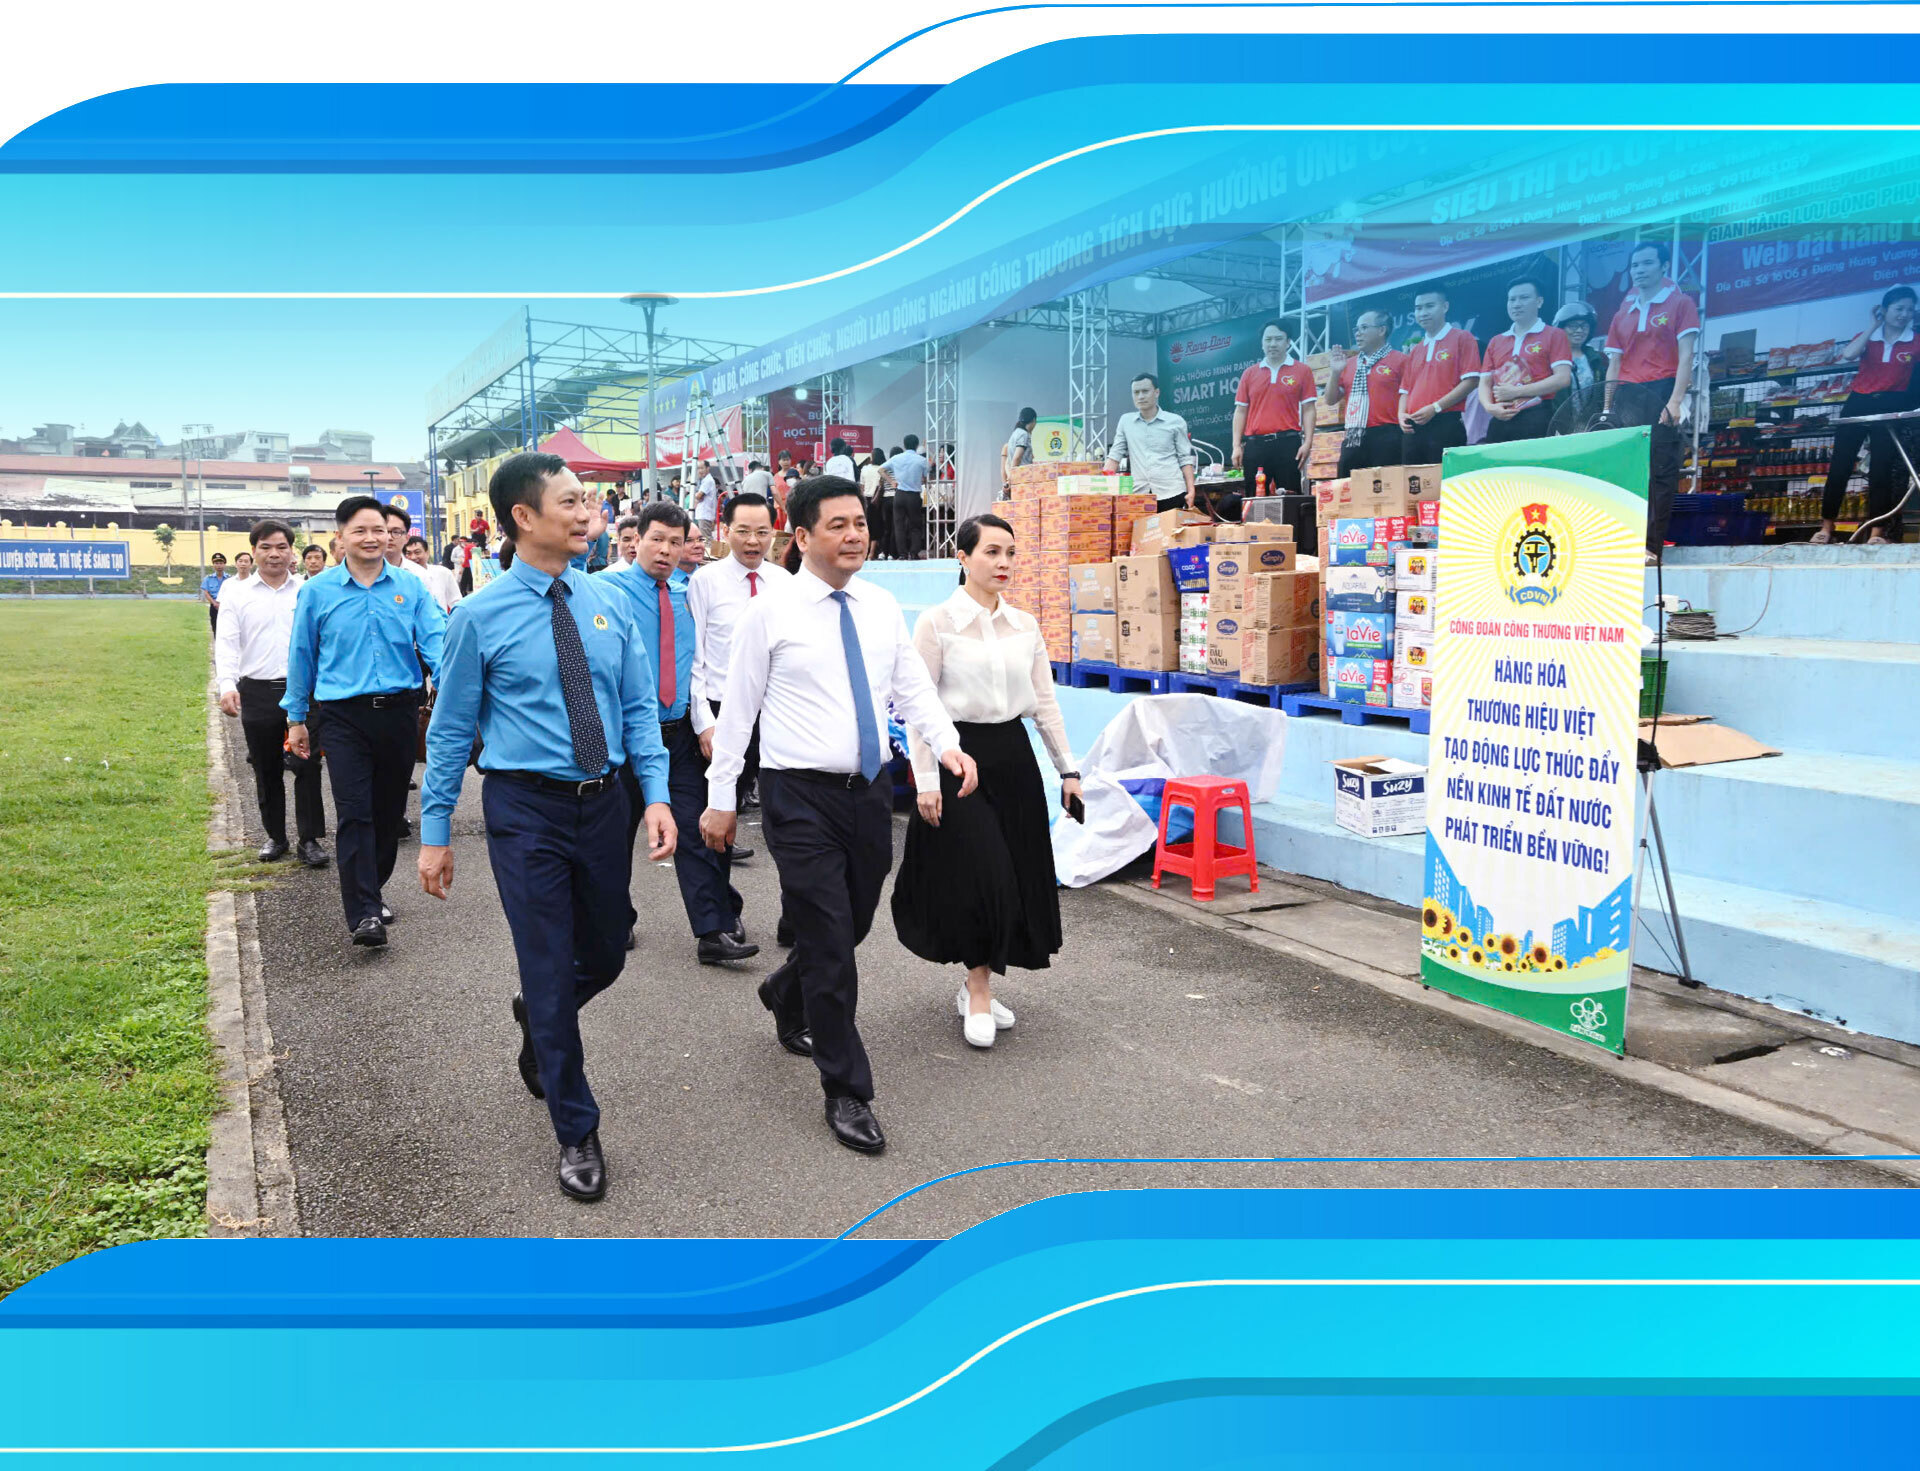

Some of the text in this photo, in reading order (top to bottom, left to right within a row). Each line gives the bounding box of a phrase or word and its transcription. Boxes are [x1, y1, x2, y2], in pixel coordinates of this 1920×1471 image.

[1429, 178, 1498, 224] SIÊU
[1507, 160, 1557, 203] THỊ
[1624, 174, 1664, 195] Phường
[1667, 166, 1686, 182] Gia
[1708, 180, 1920, 243] GIAN HÀNG LƯU ĐỘNG PHỤ
[1741, 239, 1790, 271] Web
[1797, 228, 1834, 262] đặt
[1840, 218, 1904, 251] hàng
[712, 377, 726, 397] CÁN
[739, 361, 759, 387] CÔNG
[760, 352, 784, 379] CHỨC,
[785, 343, 805, 370] VIÊN
[806, 332, 834, 360] CHỨC,
[836, 317, 868, 352] NGƯỜI
[869, 315, 891, 340] LAO
[892, 298, 927, 335] ĐỘNG
[929, 276, 977, 320] NGÀNH
[980, 259, 1022, 301] CÔNG
[1025, 230, 1094, 285] THƯƠNG
[1099, 210, 1144, 258] TÍCH
[1149, 191, 1193, 243] CỰC
[1200, 157, 1288, 222] HƯỞNG
[1715, 281, 1731, 293] Địa
[1812, 261, 1846, 276] Đường
[1873, 268, 1899, 282] Điện
[1213, 363, 1232, 376] MINH
[1173, 378, 1240, 404] SMART HO
[783, 427, 807, 440] HỌC
[3, 549, 24, 571] LUYỆN
[25, 548, 38, 569] SỨC
[59, 549, 70, 569] TRÍ
[93, 550, 111, 569] SÁNG
[111, 553, 124, 572] TẠO
[1189, 608, 1208, 618] Heine
[1189, 634, 1207, 644] Heine
[1346, 625, 1381, 642] laVie
[1449, 617, 1625, 645] CÔNG ĐOÀN CÔNG THƯƠNG VIỆT NAM
[1187, 660, 1207, 671] Heine
[1337, 669, 1366, 684] laVie
[1494, 655, 1567, 688] HÀNG HÓA
[1467, 698, 1595, 741] THƯƠNG HIỆU VIỆT
[1444, 736, 1620, 785] TẠO ĐỘNG LỰC THÚC ĐẨY
[1341, 773, 1360, 792] Suzy
[1382, 778, 1413, 796] Suzy
[1447, 772, 1612, 829] NỀN KINH TẾ ĐẤT NƯỚC
[1445, 816, 1610, 875] PHÁT TRIỂN BỀN VỮNG!
